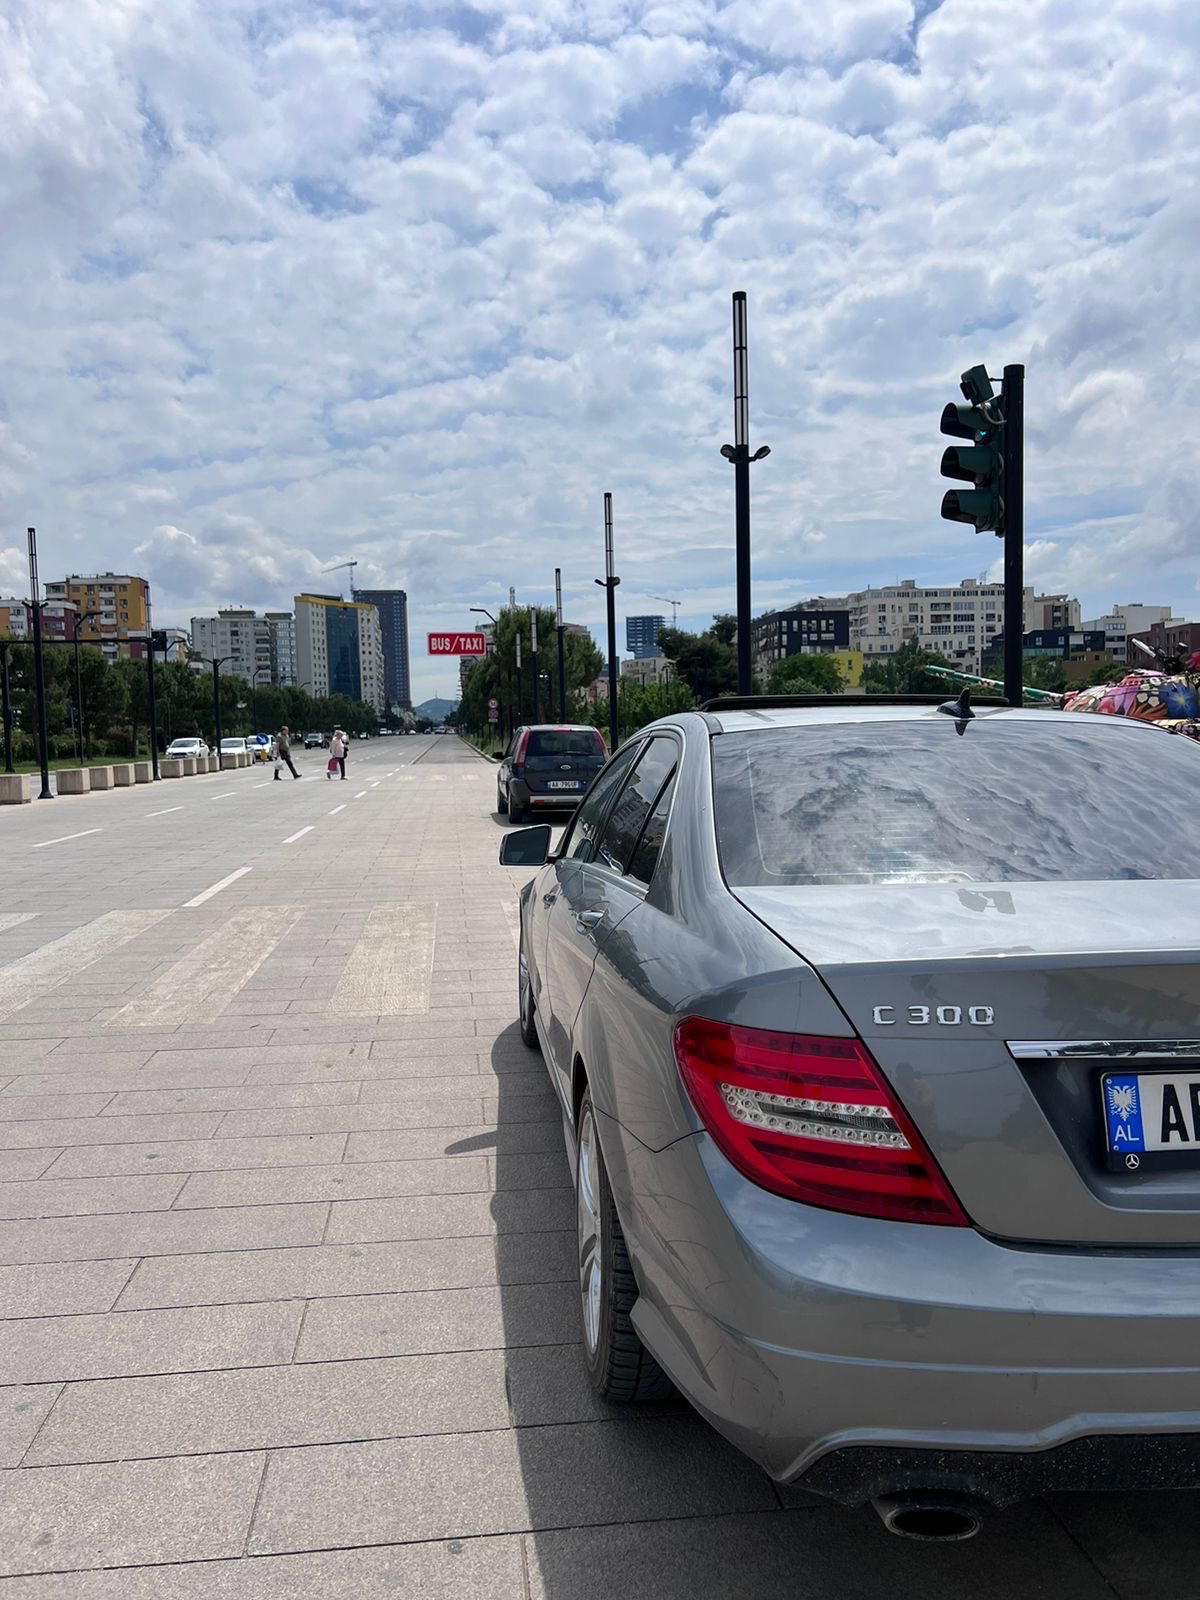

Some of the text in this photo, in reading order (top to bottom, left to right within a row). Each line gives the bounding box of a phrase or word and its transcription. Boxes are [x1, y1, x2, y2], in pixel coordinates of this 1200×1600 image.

[431, 636, 482, 652] BUS/TAXI
[872, 1005, 995, 1026] C 300
[1114, 1125, 1140, 1142] AL
